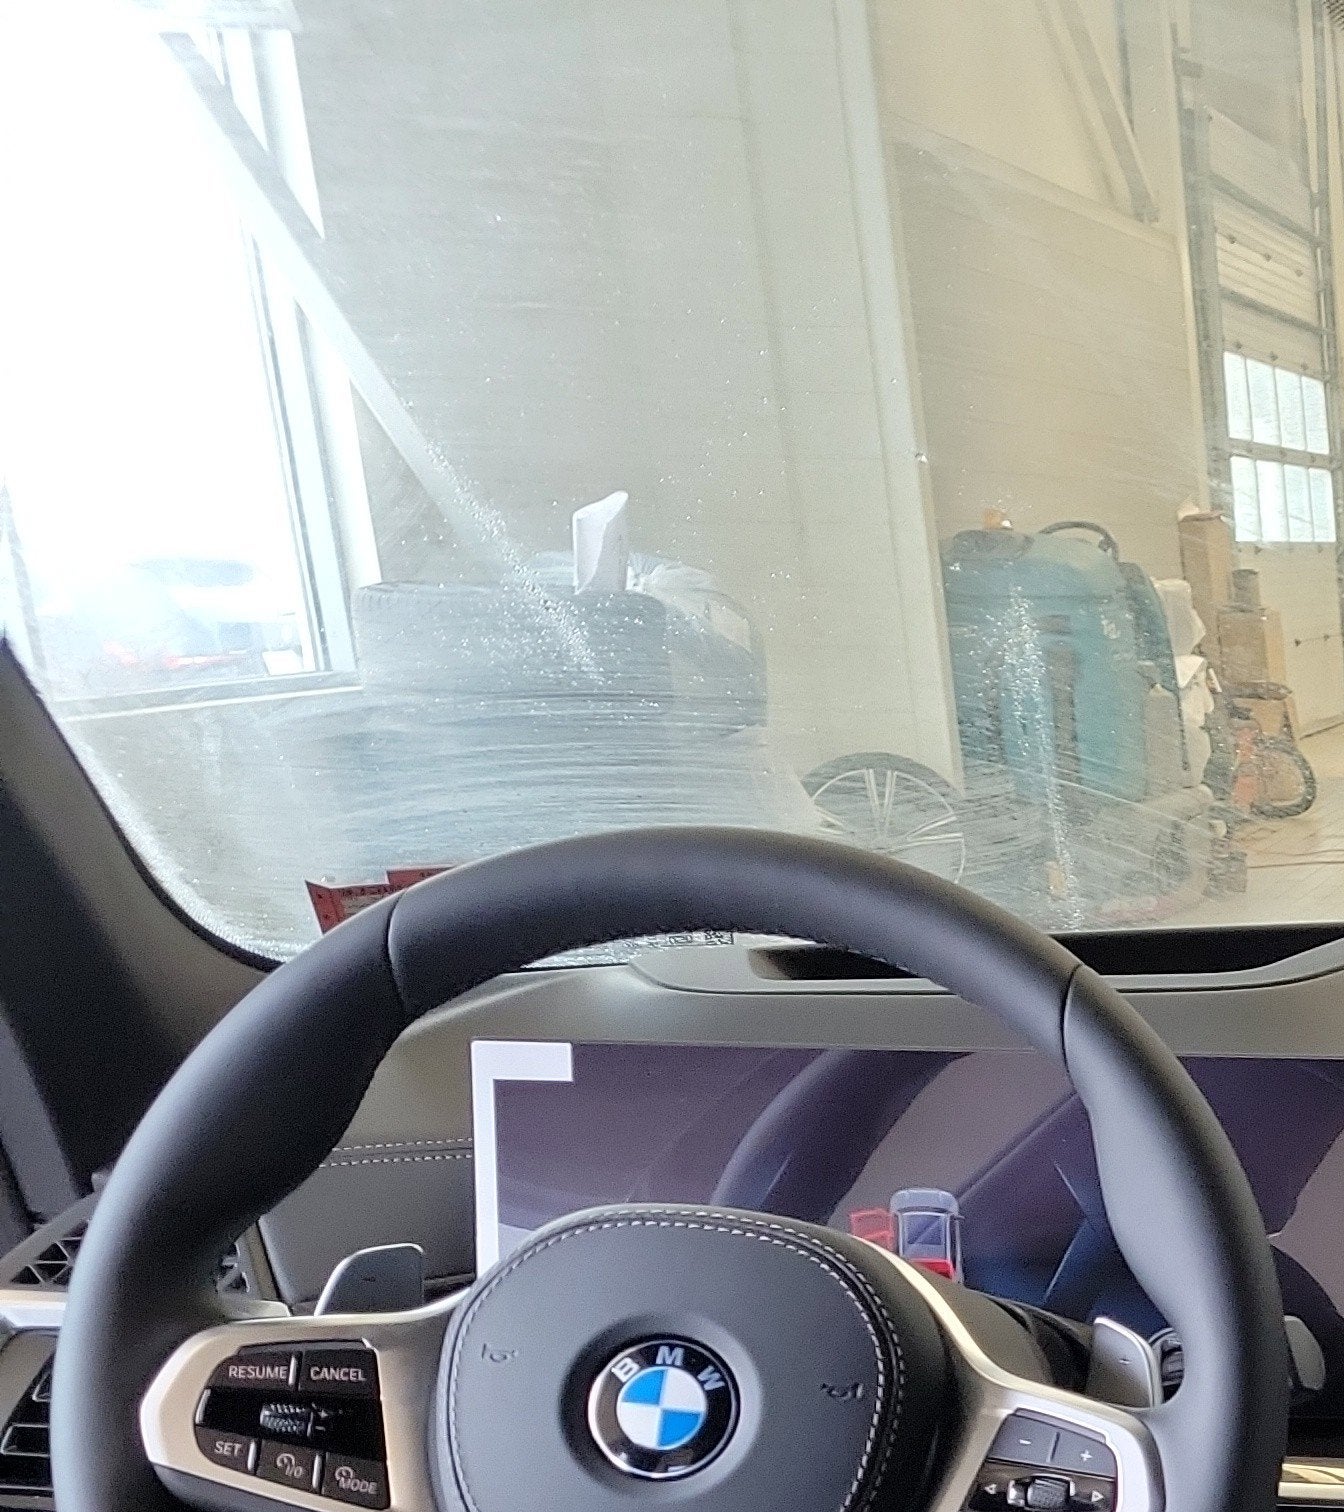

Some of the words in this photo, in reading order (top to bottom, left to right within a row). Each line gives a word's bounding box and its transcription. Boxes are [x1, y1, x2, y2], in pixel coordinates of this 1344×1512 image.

[228, 1365, 289, 1379] RESUME
[310, 1366, 367, 1382] CANCEL
[611, 1345, 726, 1392] BMW
[214, 1441, 242, 1457] SET
[338, 1475, 378, 1495] MODE
